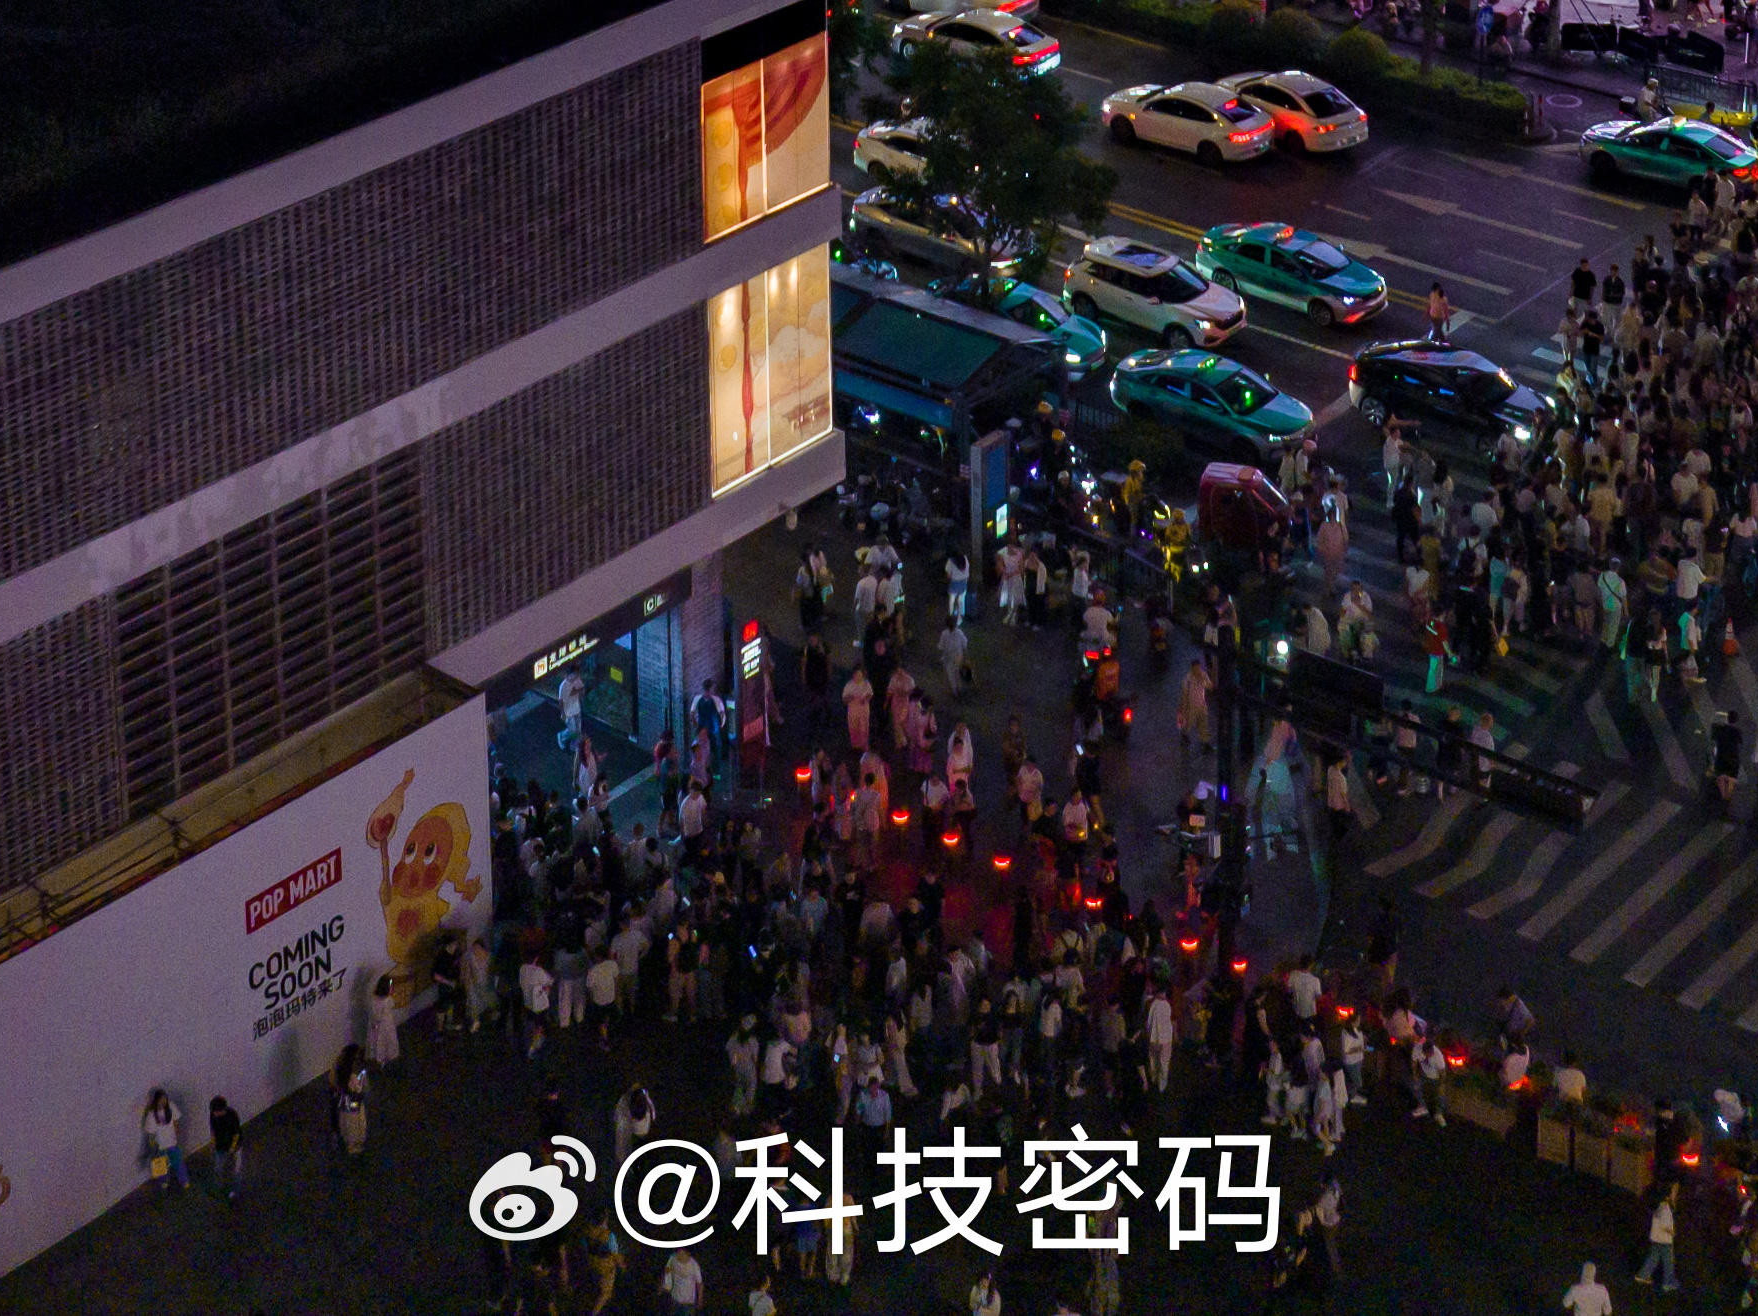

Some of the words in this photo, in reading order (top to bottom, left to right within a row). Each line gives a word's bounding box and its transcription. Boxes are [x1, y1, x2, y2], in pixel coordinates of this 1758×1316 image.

[250, 888, 285, 928] POP
[290, 855, 337, 905] MART
[249, 915, 345, 990] COMING
[264, 948, 332, 1010] SOON
[253, 968, 347, 1041] 泡泡玛特来了
